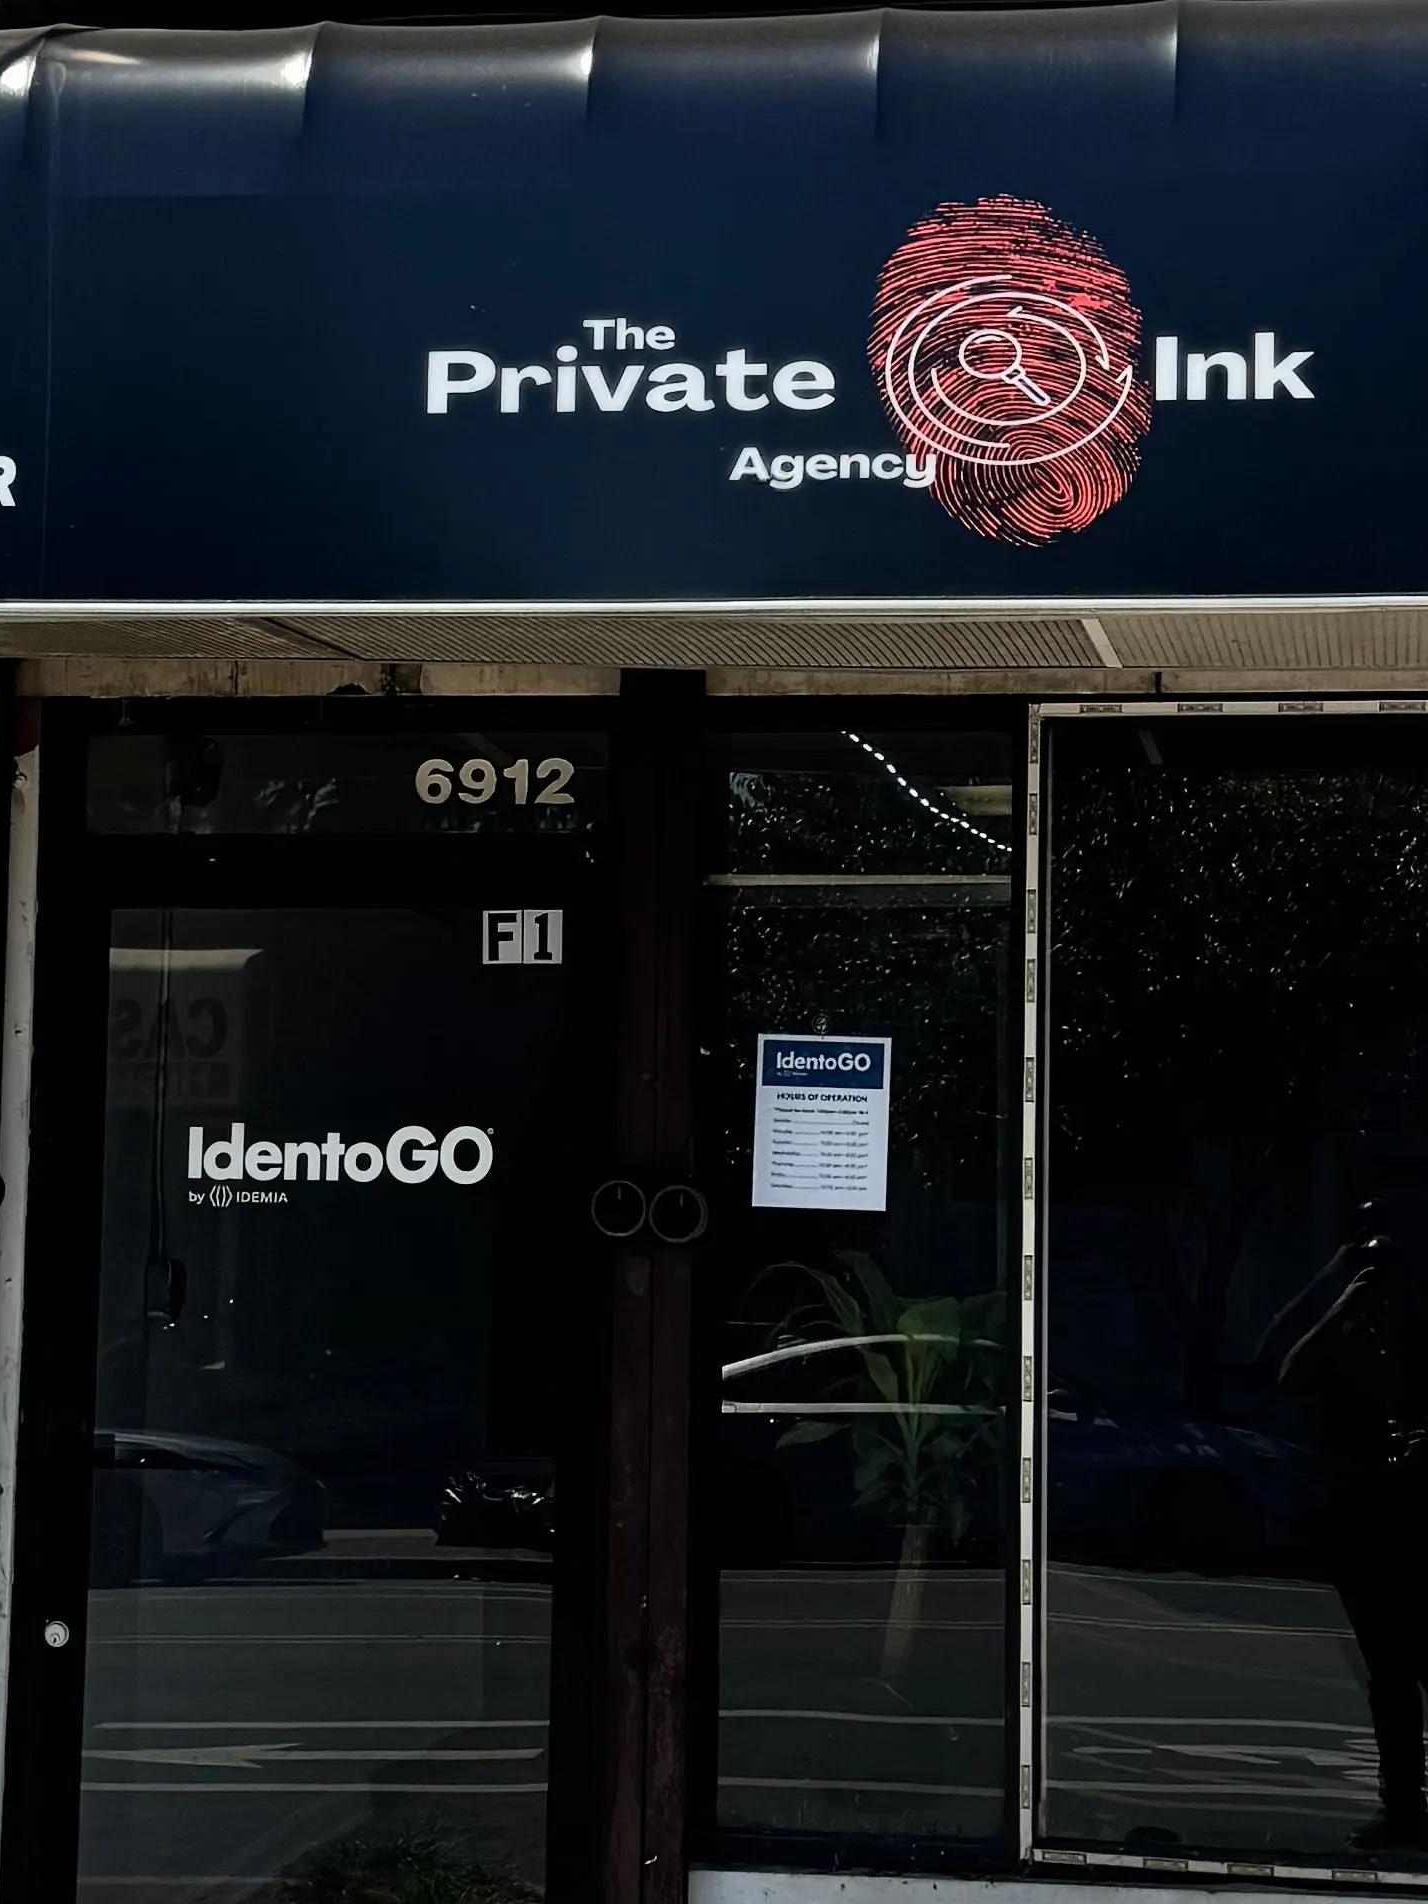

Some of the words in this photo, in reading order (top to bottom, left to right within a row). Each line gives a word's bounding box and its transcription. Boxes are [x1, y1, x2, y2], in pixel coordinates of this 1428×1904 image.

[582, 317, 676, 352] The
[425, 346, 837, 414] Private
[1155, 331, 1315, 402] Ink
[728, 446, 937, 490] Agency
[415, 757, 575, 805] 6912
[487, 912, 553, 961] F1
[776, 1050, 871, 1072] IdentoGO
[187, 1122, 493, 1185] IdentoGO
[188, 1190, 206, 1205] by
[236, 1191, 289, 1204] IDEMIA
